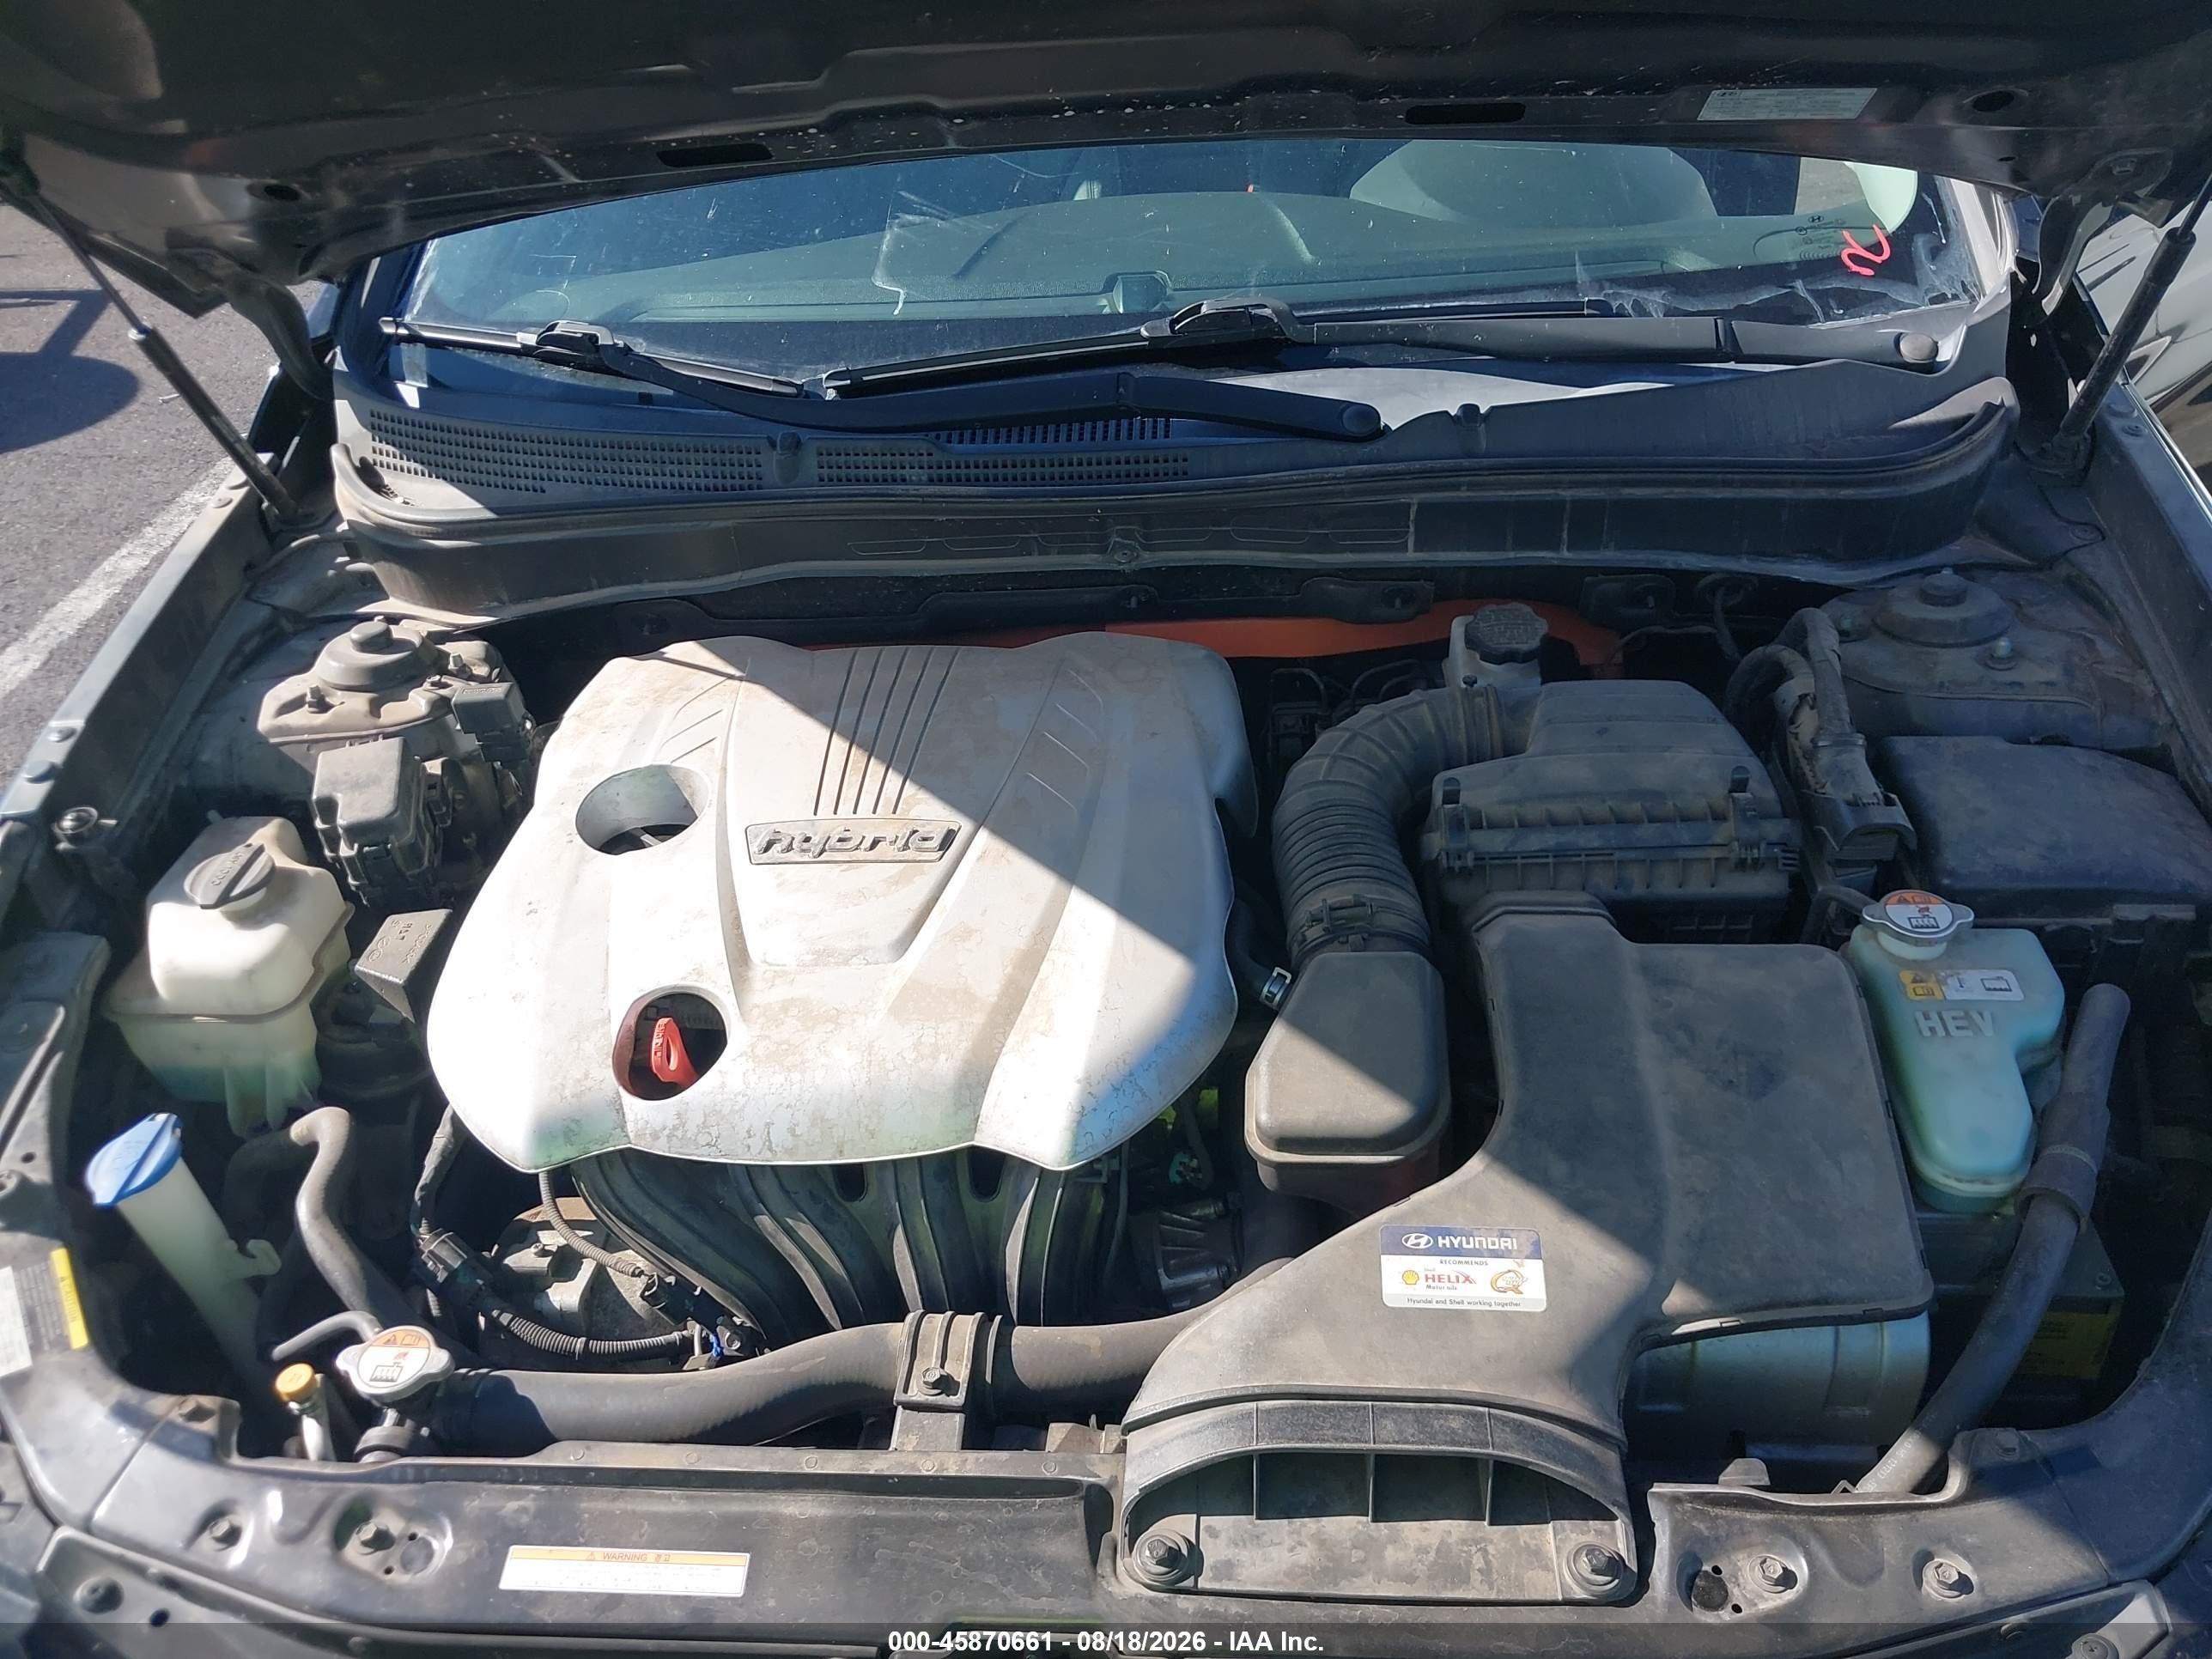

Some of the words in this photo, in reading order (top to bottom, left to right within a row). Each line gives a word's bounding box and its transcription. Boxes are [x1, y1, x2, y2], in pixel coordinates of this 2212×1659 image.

[754, 826, 957, 860] hybrid
[1914, 1010, 1996, 1037] HEV
[1437, 1236, 1518, 1250] HYUNDAI
[1439, 1258, 1489, 1267] RECOMMENDS
[1425, 1271, 1477, 1285] HELIX
[1466, 1299, 1492, 1308] working
[602, 1552, 648, 1562] WARNING
